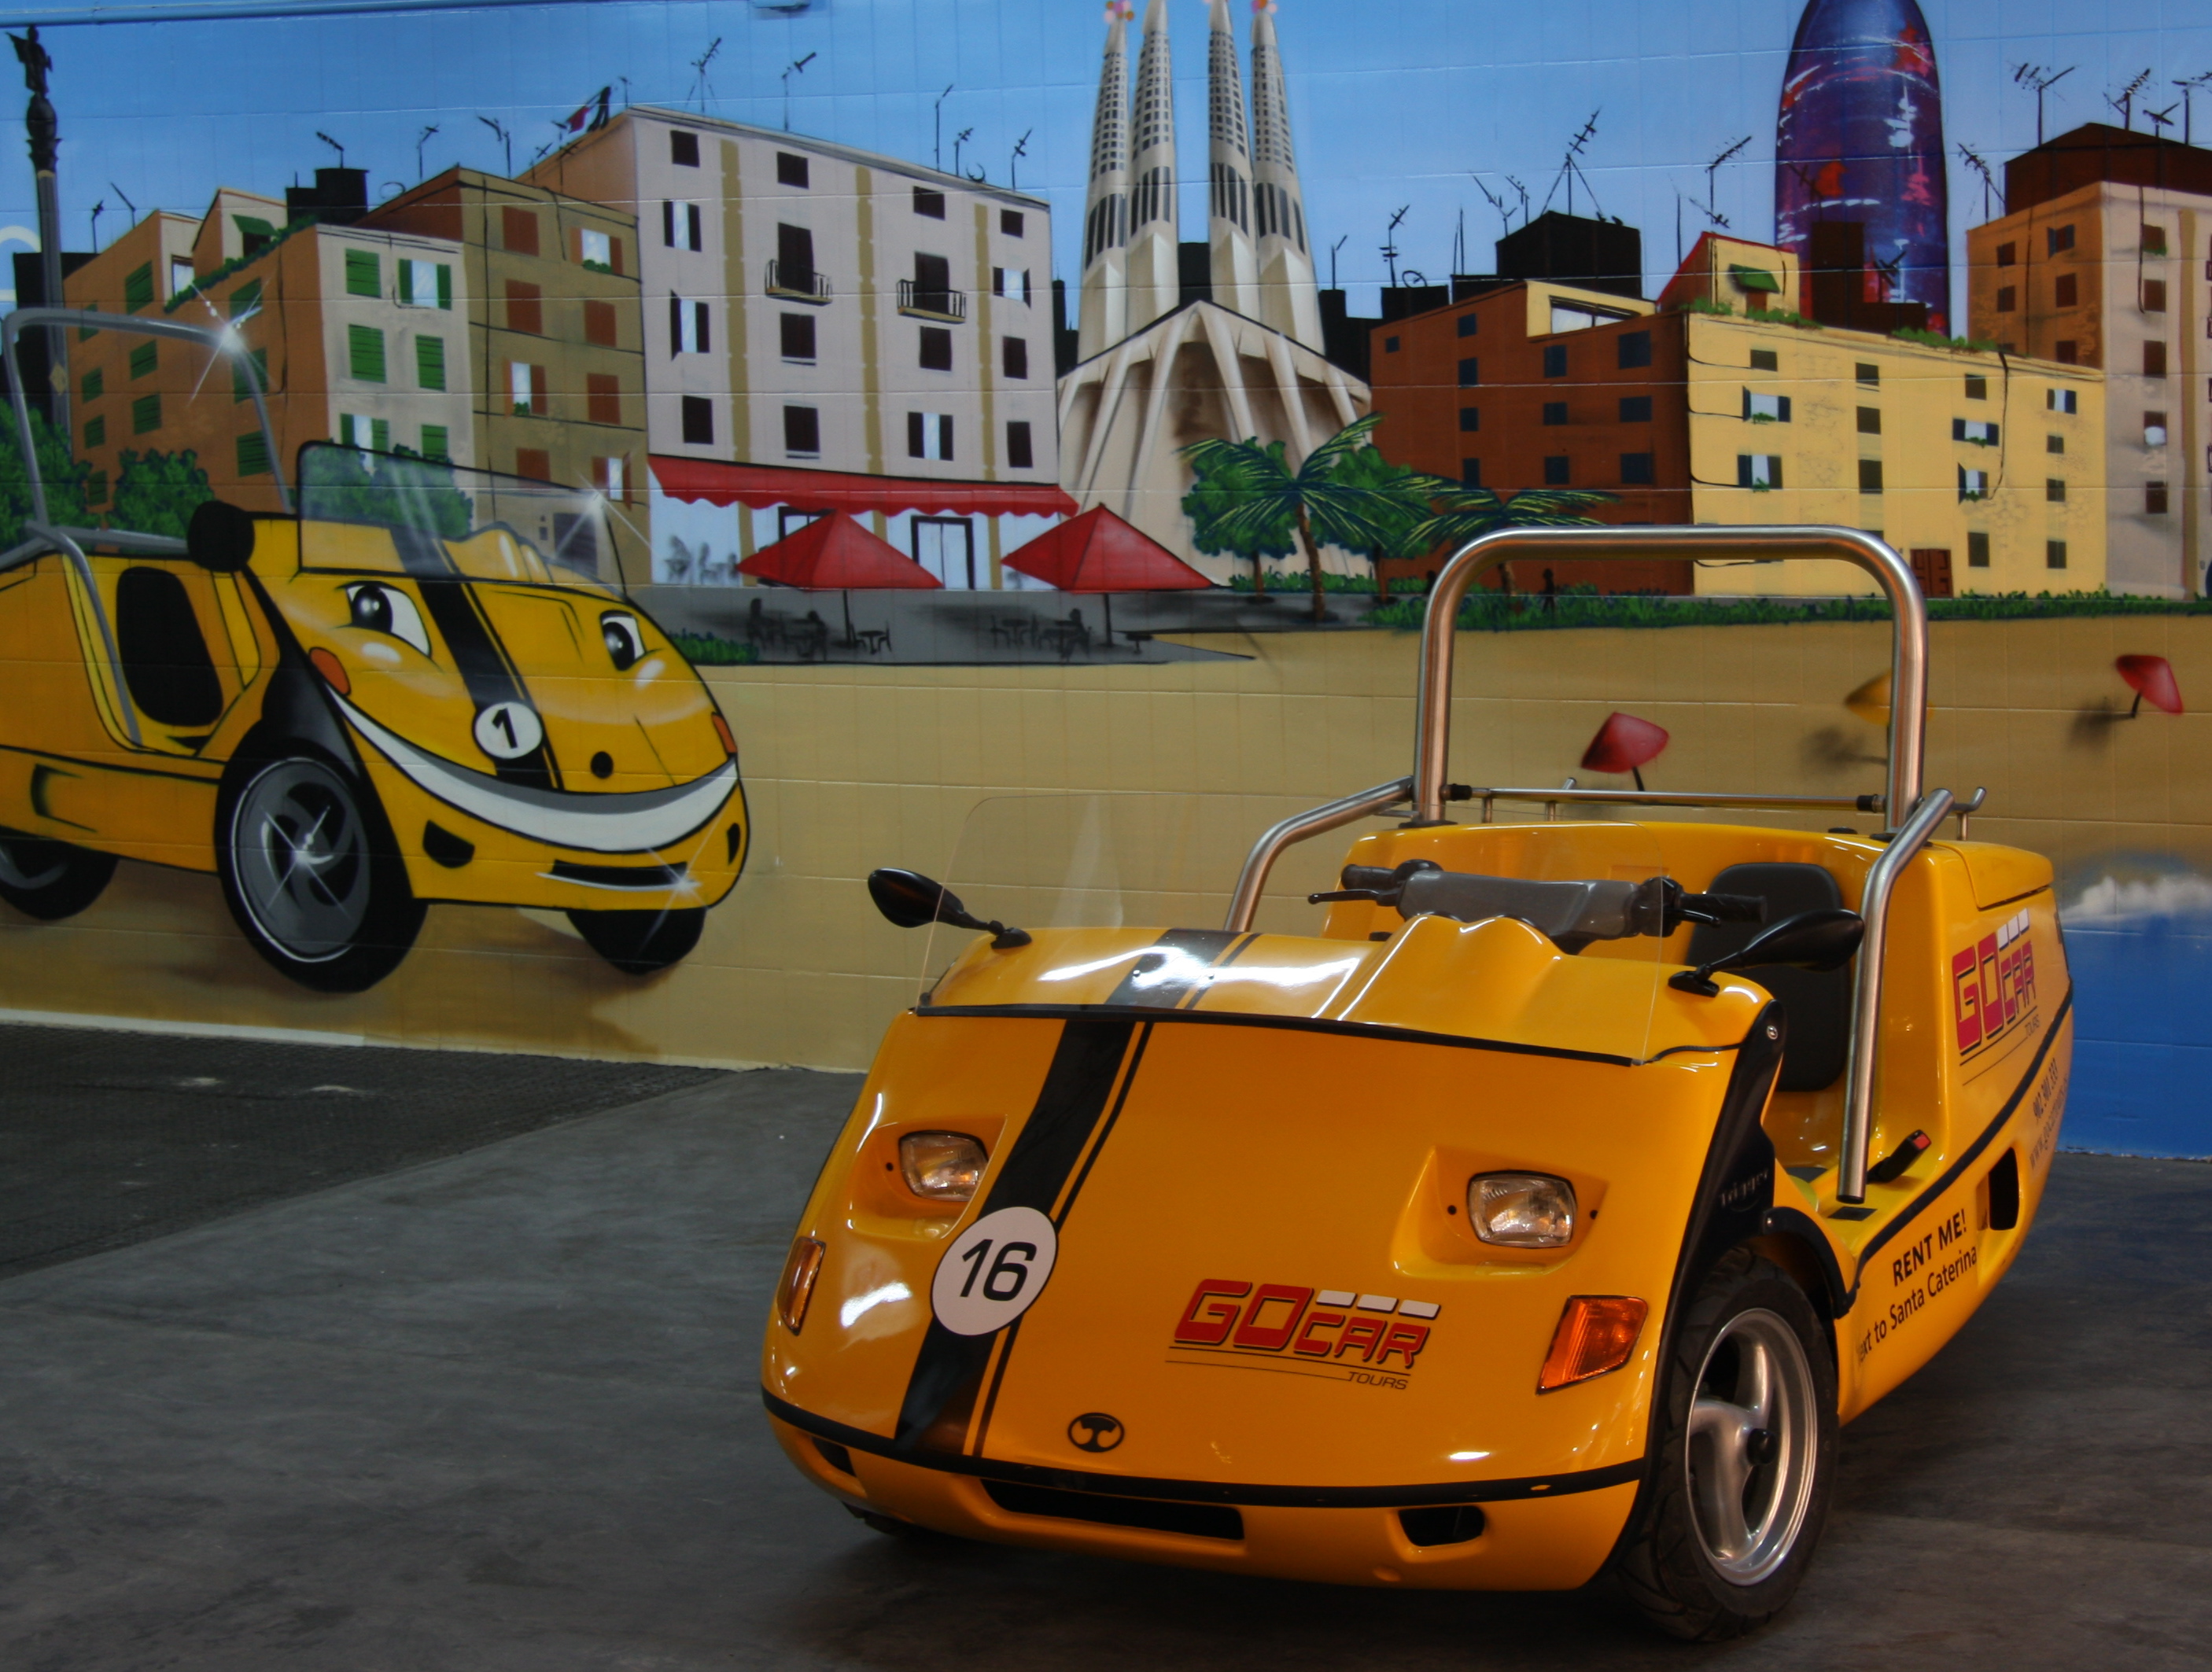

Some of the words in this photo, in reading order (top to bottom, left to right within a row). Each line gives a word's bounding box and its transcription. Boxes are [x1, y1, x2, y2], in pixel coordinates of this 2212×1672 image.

[492, 707, 518, 749] 1
[960, 1239, 1037, 1302] 16
[1893, 1233, 1932, 1287] RENT
[1937, 1208, 1967, 1250] ME!
[1174, 1279, 1431, 1369] GOCAR
[1874, 1320, 1887, 1343] to
[1889, 1288, 1925, 1330] Santa
[1927, 1246, 1977, 1298] Caterina
[1347, 1372, 1409, 1390] TOURS
